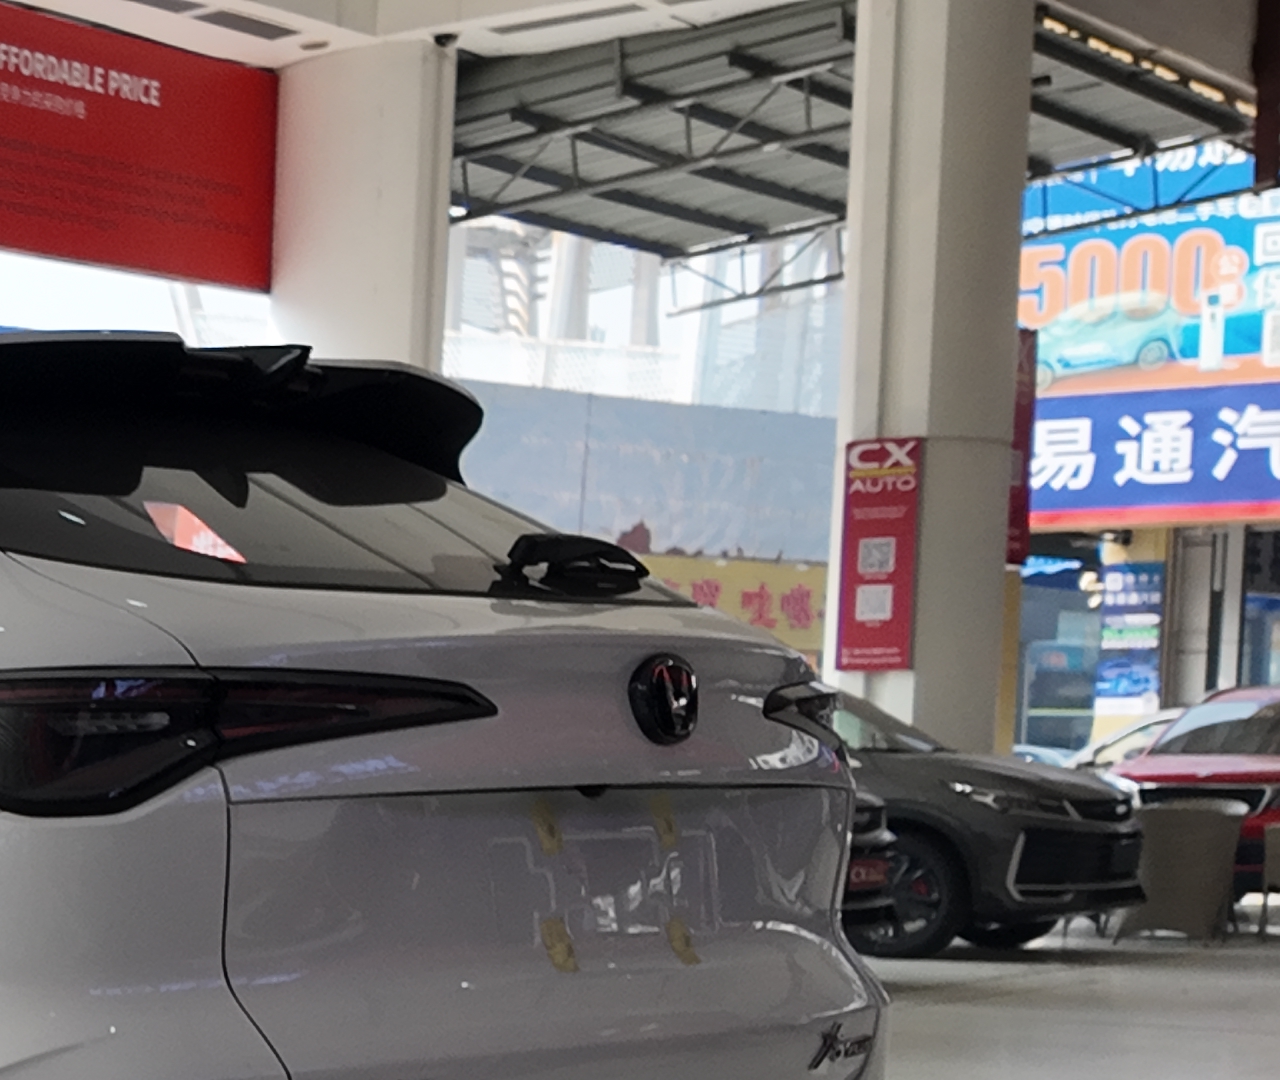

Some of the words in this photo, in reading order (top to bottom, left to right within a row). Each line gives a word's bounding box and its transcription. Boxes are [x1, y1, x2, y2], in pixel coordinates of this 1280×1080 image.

[108, 69, 162, 108] PRICE
[848, 441, 917, 469] CX
[849, 476, 917, 494] AUTO
